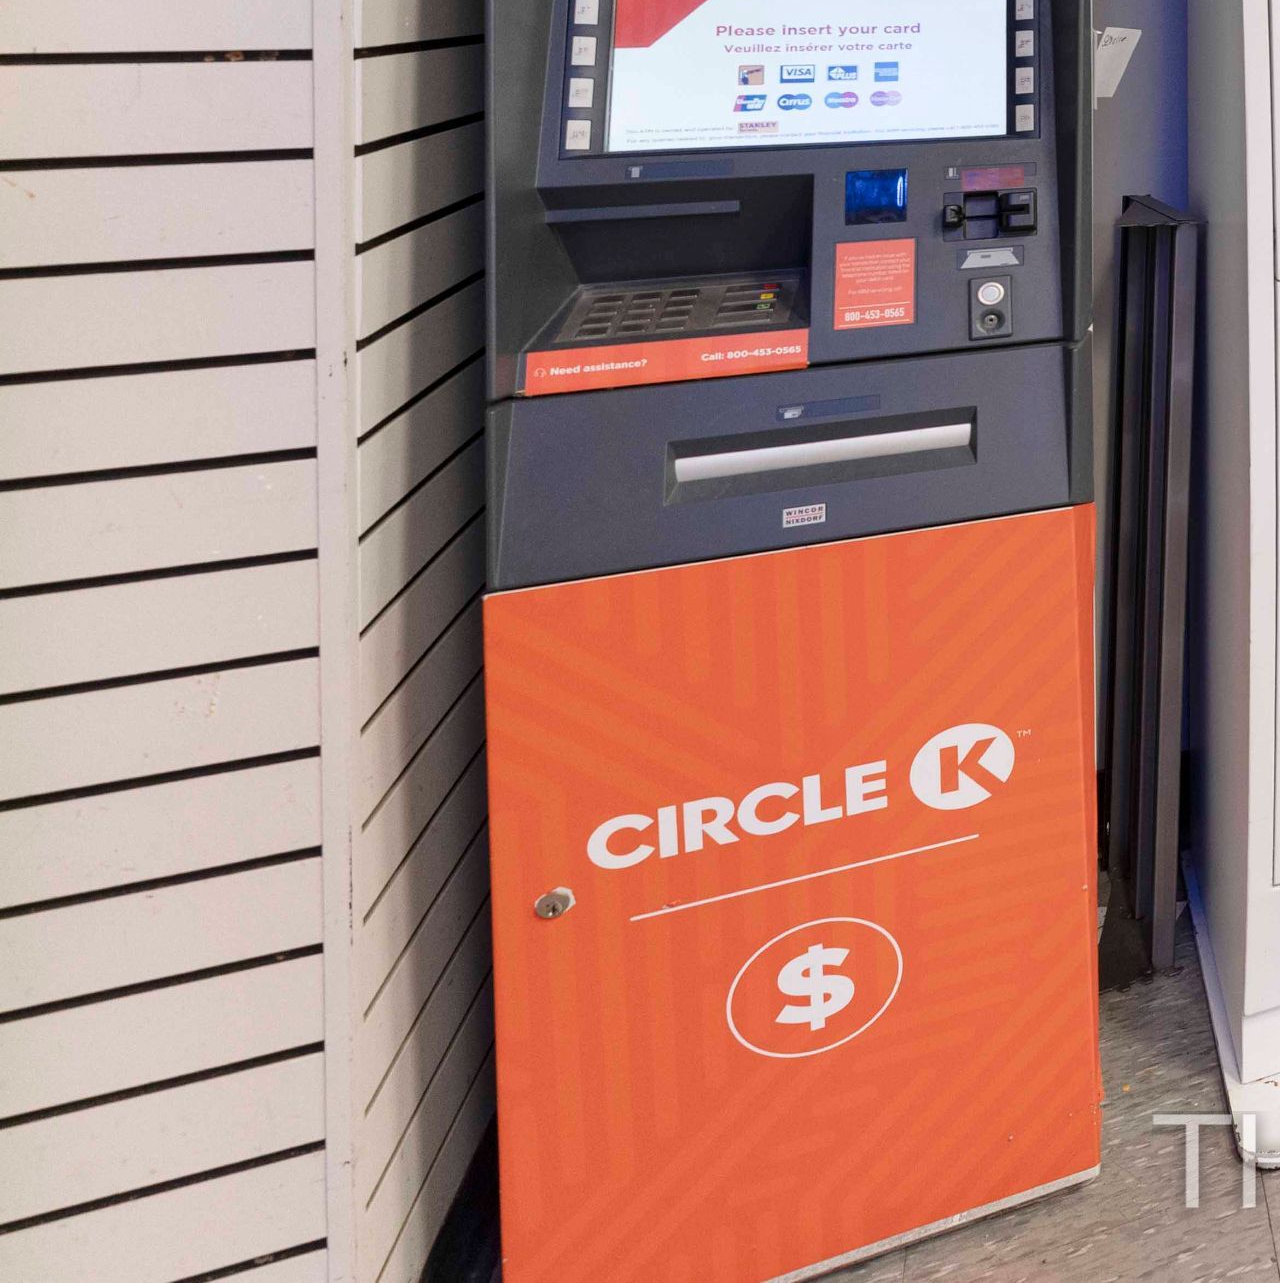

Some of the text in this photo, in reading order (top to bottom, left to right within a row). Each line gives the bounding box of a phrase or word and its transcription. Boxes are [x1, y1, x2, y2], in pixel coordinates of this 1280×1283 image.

[715, 22, 921, 39] Please insert your card
[723, 41, 913, 54] Veuillez insérer votre carte
[786, 69, 812, 77] VISA
[844, 307, 905, 322] 800-453-0565
[701, 345, 802, 362] Call: 800-453-0565
[550, 358, 648, 376] Need assistance?
[586, 722, 1016, 870] CIRCLE K
